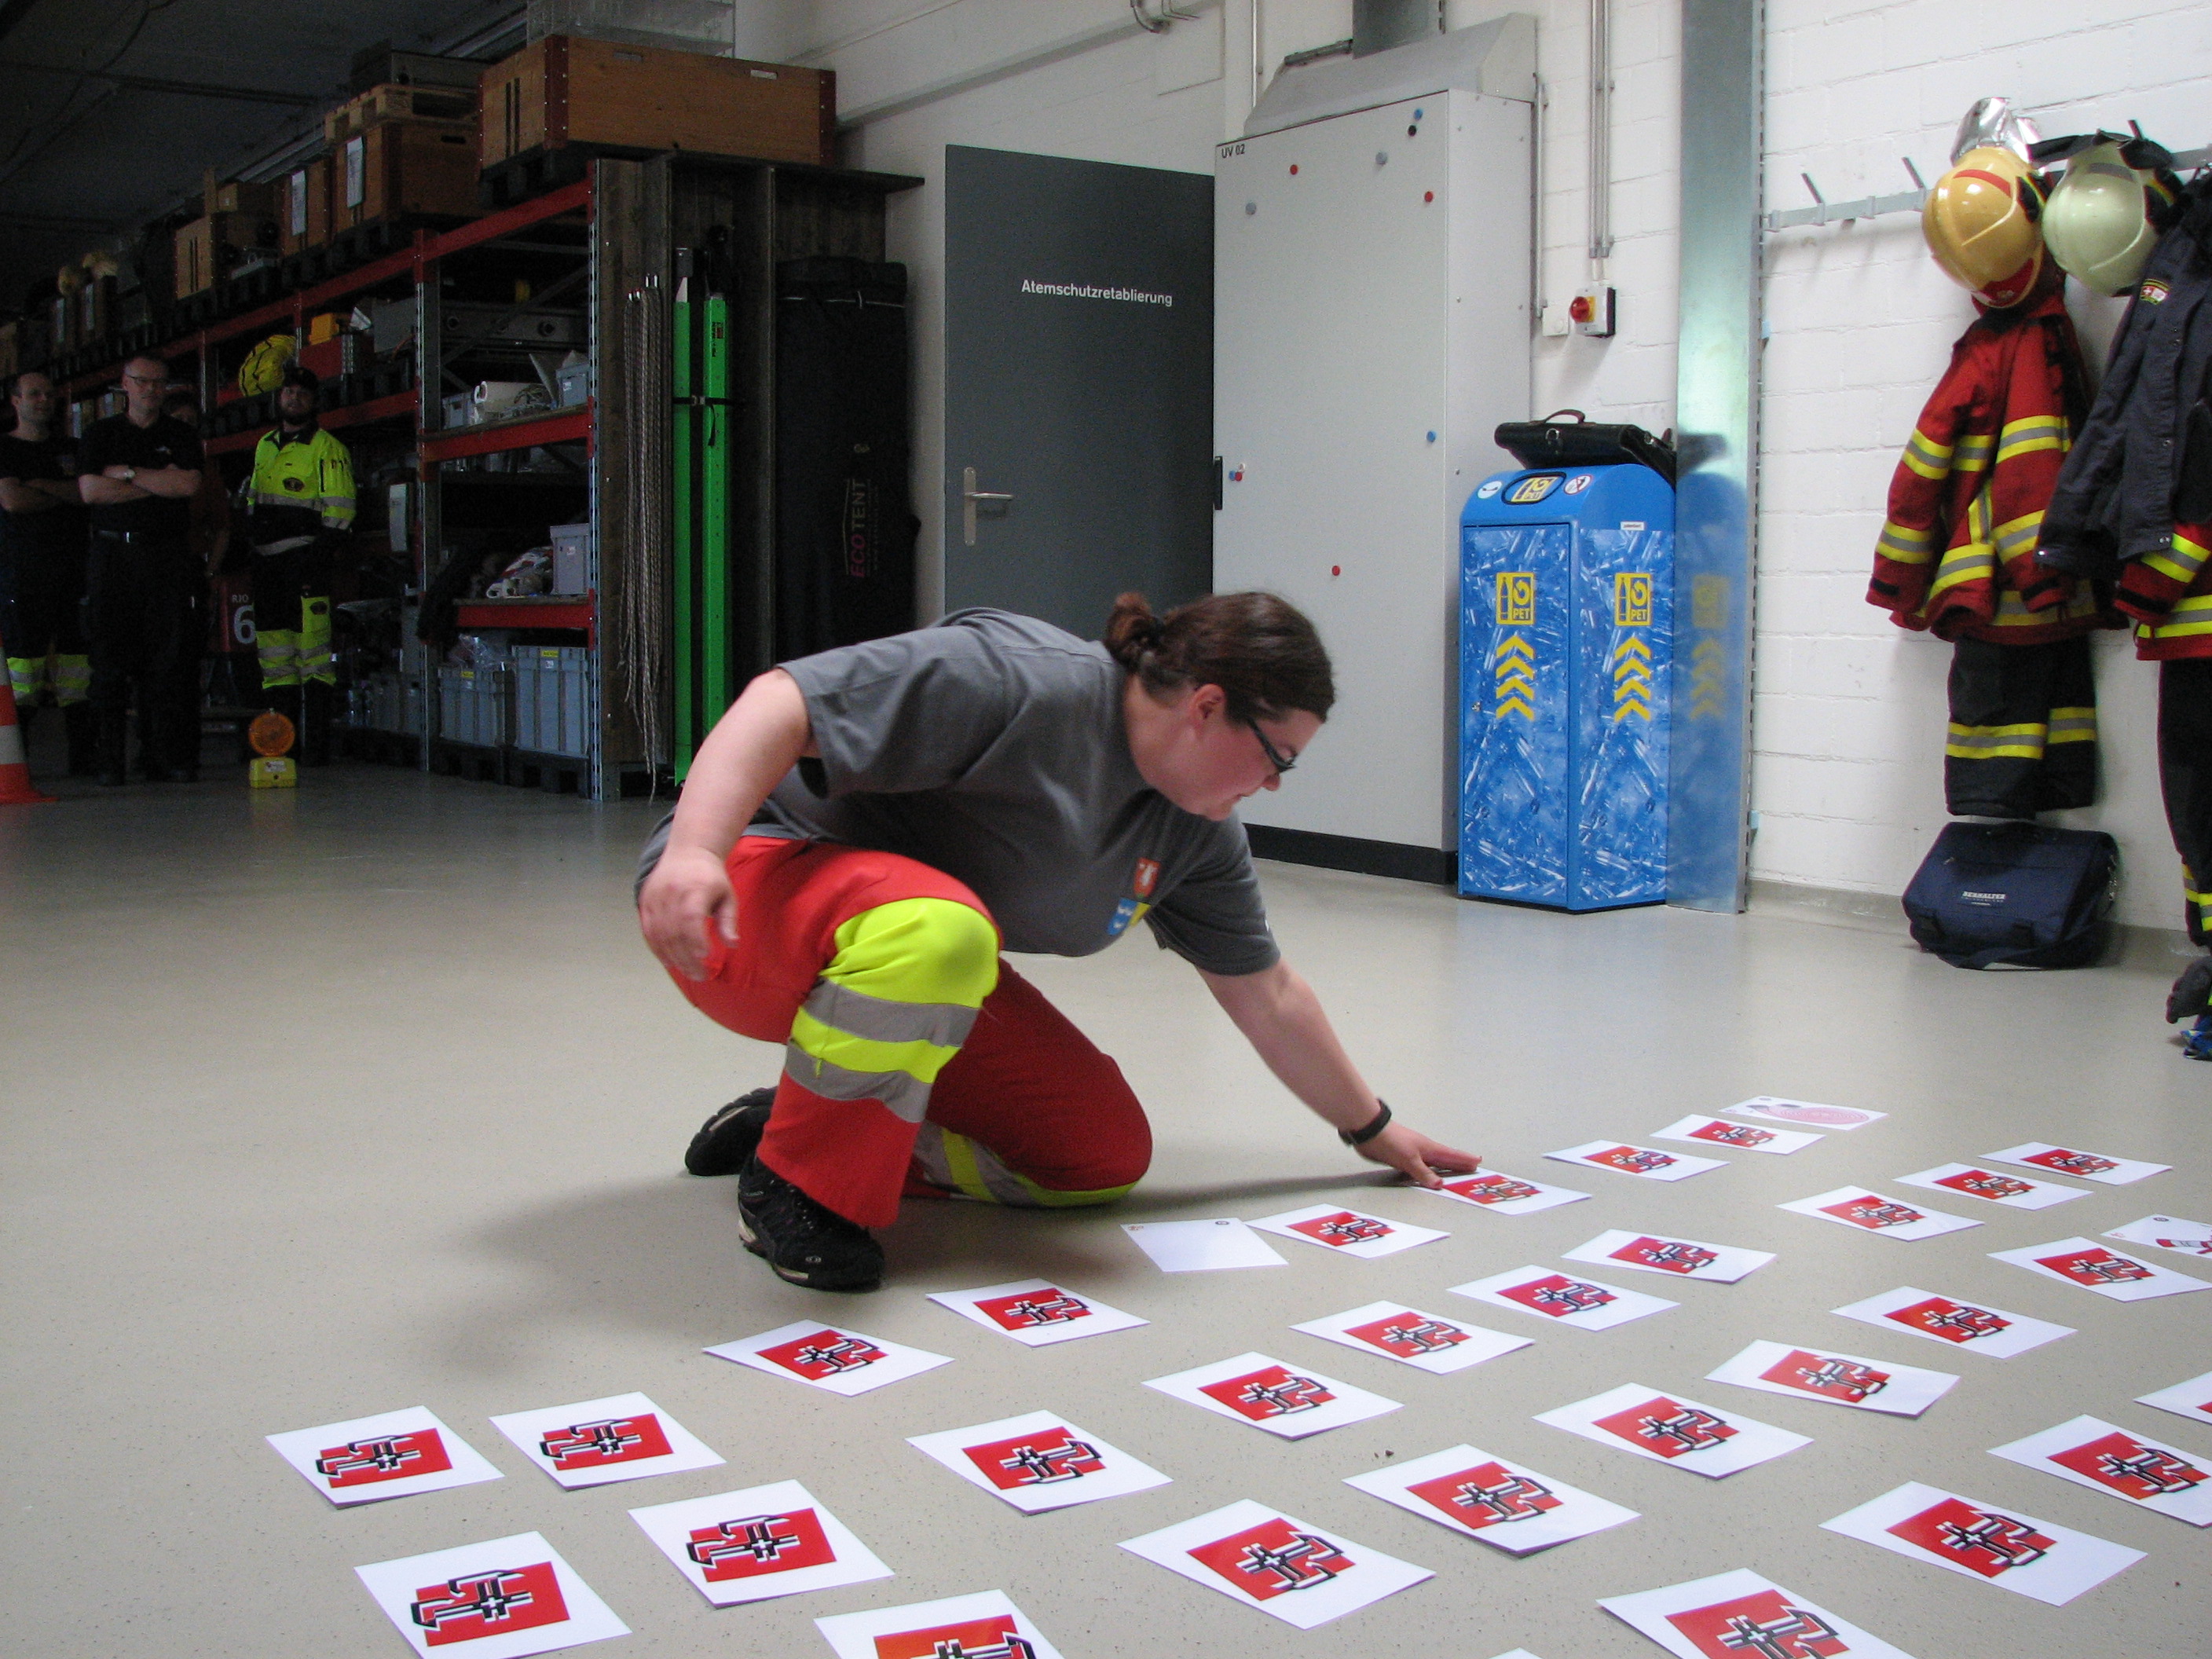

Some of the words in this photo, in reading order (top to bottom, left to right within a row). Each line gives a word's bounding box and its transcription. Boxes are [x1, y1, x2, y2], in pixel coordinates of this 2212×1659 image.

[1221, 145, 1233, 159] UV
[1235, 143, 1245, 156] 02
[1022, 279, 1173, 307] Atemschutzretablierung
[1513, 608, 1531, 620] PET
[1631, 609, 1648, 621] PET
[234, 604, 256, 644] 6
